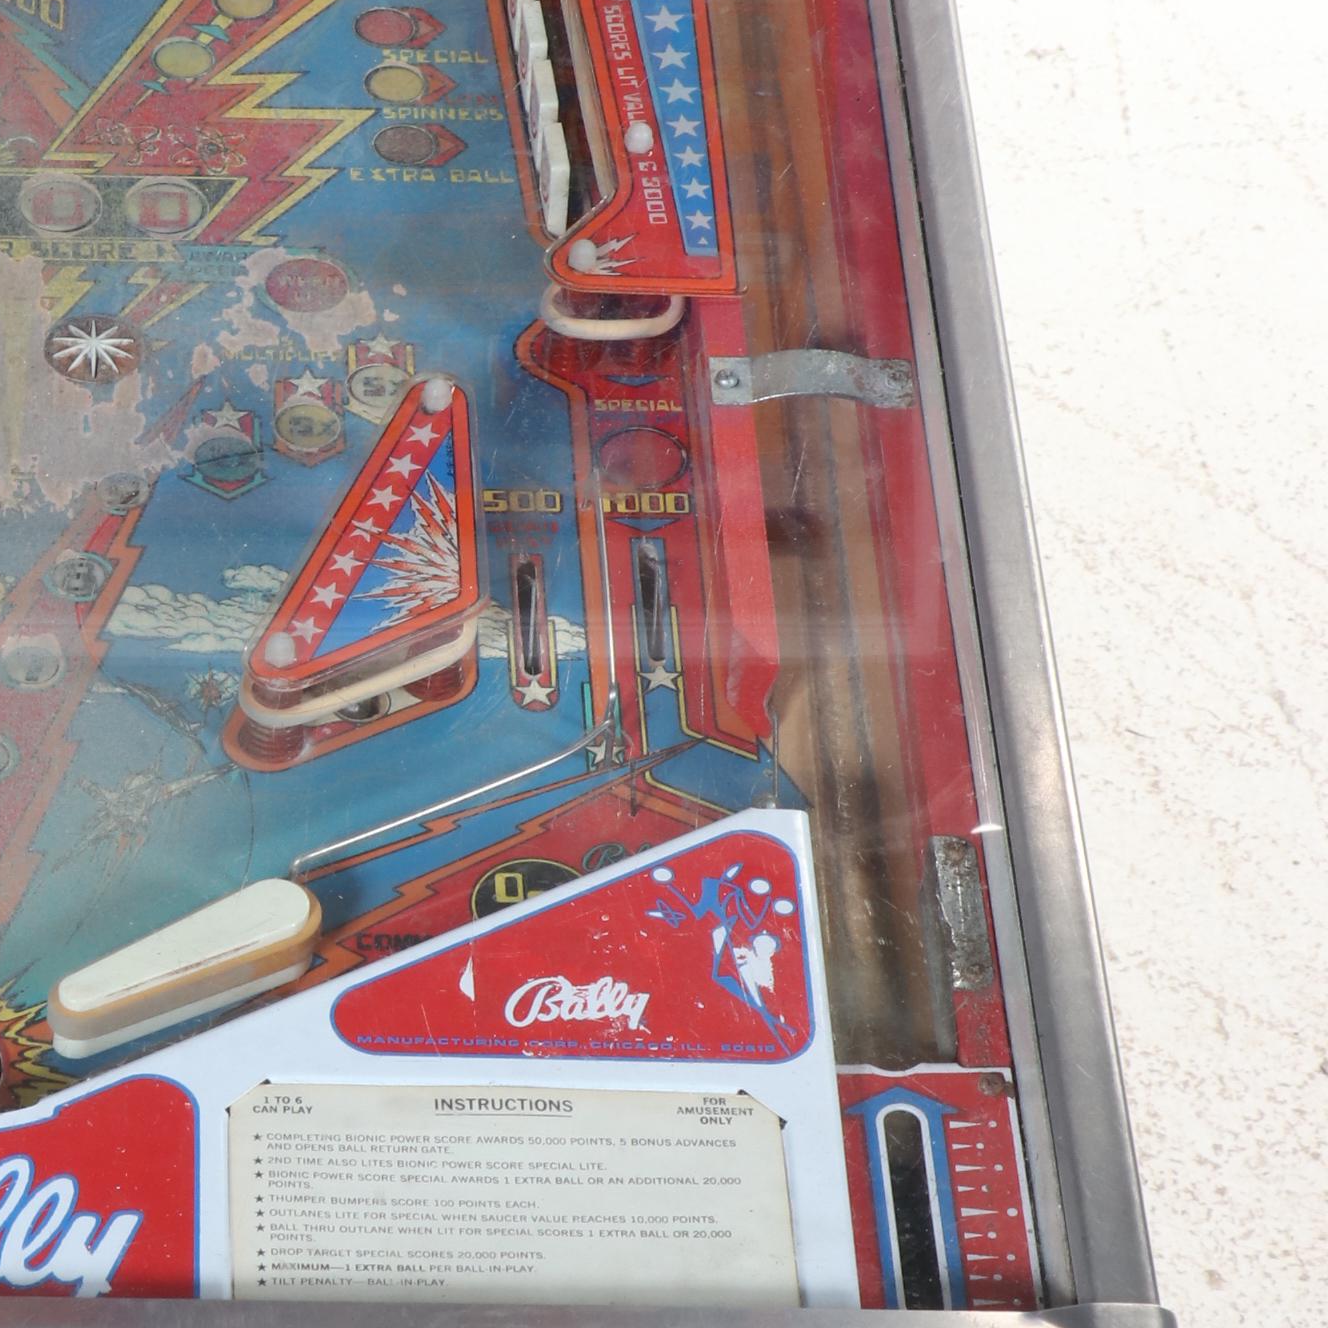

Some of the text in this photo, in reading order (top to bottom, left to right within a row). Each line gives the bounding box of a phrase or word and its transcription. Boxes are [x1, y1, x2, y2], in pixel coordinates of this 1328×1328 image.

[605, 5, 632, 61] SCORES
[382, 49, 489, 63] SPECIAL
[618, 66, 640, 88] LIT
[383, 108, 505, 121] SPINNERS
[350, 168, 436, 182] EXTRA
[642, 177, 668, 224] 3000
[594, 399, 683, 412] SPECIAL
[482, 489, 562, 512] 500
[505, 976, 650, 1030] Bally
[356, 1035, 520, 1047] MANUFACTURING
[591, 1041, 672, 1051] CHICAGO
[434, 1098, 573, 1113] INSTRUCTIONS
[703, 1097, 726, 1106] FOR
[253, 1106, 313, 1114] CAN PLAY
[676, 1107, 754, 1115] AMUSEMENT
[700, 1117, 732, 1125] ONLY
[267, 1133, 342, 1142] COMPLETING
[345, 1135, 386, 1143] BIONIC
[434, 1136, 472, 1144] SCORE
[477, 1136, 524, 1145] AWARDS
[528, 1137, 566, 1146] 50,000
[631, 1138, 671, 1147] BONUS
[676, 1139, 736, 1147] ADVANCES
[267, 1143, 291, 1151] AND
[295, 1144, 333, 1152] OPENS
[339, 1144, 366, 1152] BALL
[371, 1145, 418, 1153] RETURN
[270, 1195, 540, 1209] THUMPER BUMPERS SCORE 100 POINTS EACH.
[271, 1248, 303, 1256] DROP
[308, 1249, 351, 1257] TARGET
[356, 1250, 403, 1258] SPECIAL
[407, 1250, 453, 1259] SCORES
[458, 1251, 496, 1259] 20,000
[355, 1263, 392, 1272] EXTRA
[397, 1264, 424, 1272] BALL
[430, 1264, 452, 1272] PER
[272, 1278, 296, 1286] TILT
